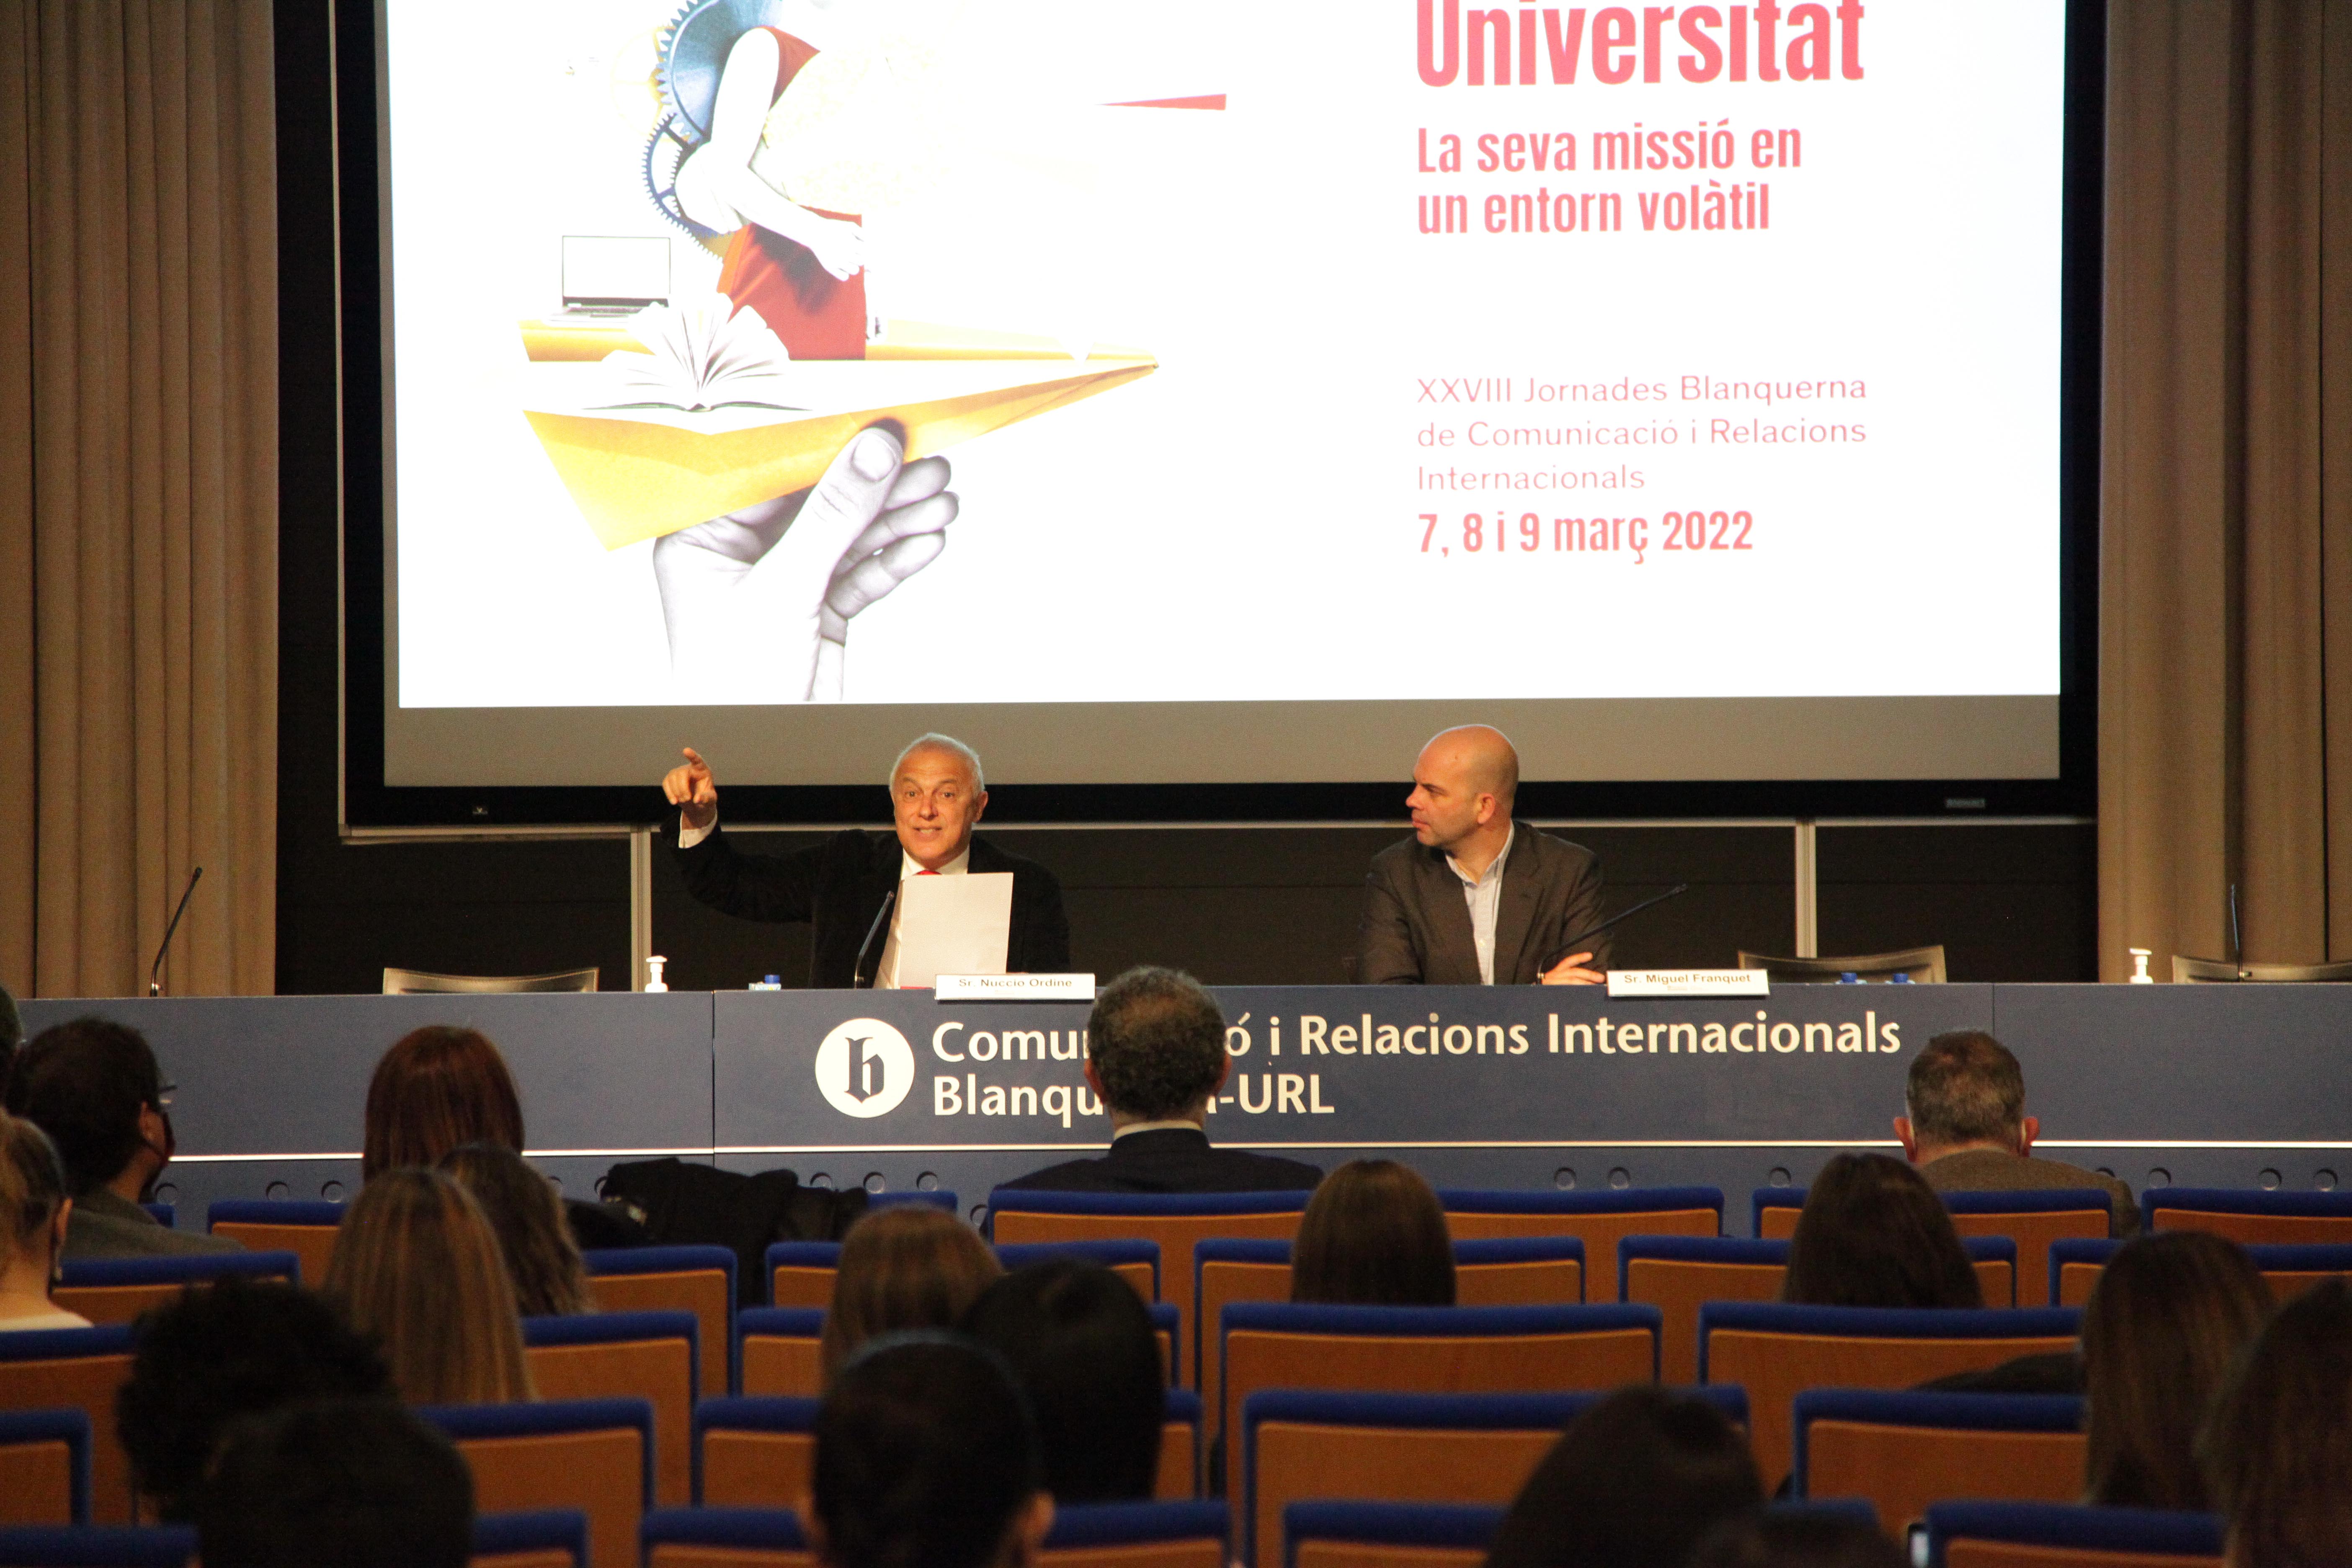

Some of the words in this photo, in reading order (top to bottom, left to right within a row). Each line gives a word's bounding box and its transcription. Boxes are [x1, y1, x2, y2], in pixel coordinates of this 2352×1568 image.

[1417, 0, 1865, 87] Universitat
[1418, 128, 1461, 173] La
[1477, 133, 1576, 173] seva
[1593, 118, 1735, 170] missió
[1751, 129, 1801, 168] en
[1418, 195, 1467, 234] un
[1484, 187, 1622, 233] entorn
[1638, 179, 1769, 231] volàtil
[1417, 377, 1511, 403] XXVIII
[1524, 376, 1668, 402] Jornades
[1681, 375, 1867, 406] Blanquerna
[1418, 422, 1455, 446] de
[1468, 419, 1678, 446] Comunicació
[1692, 419, 1696, 444] i
[1711, 417, 1867, 444] Relacions
[1419, 464, 1645, 490] Internacionals
[1418, 513, 1449, 557] 7,
[1463, 513, 1483, 552] 8
[1497, 511, 1504, 552] i
[1519, 512, 1540, 552] 9
[1554, 517, 1648, 565] març
[1662, 511, 1753, 550] 2022
[981, 979, 1025, 987] Nuccio
[1029, 978, 1072, 987] Ordine
[1624, 975, 1641, 983] Sr.
[1693, 974, 1751, 984] Franquet
[1269, 1016, 1280, 1056] i
[1301, 1013, 1529, 1055] Relacions
[1549, 1011, 1901, 1054] Internacionals
[934, 1073, 1335, 1129] Blanqu-URL
